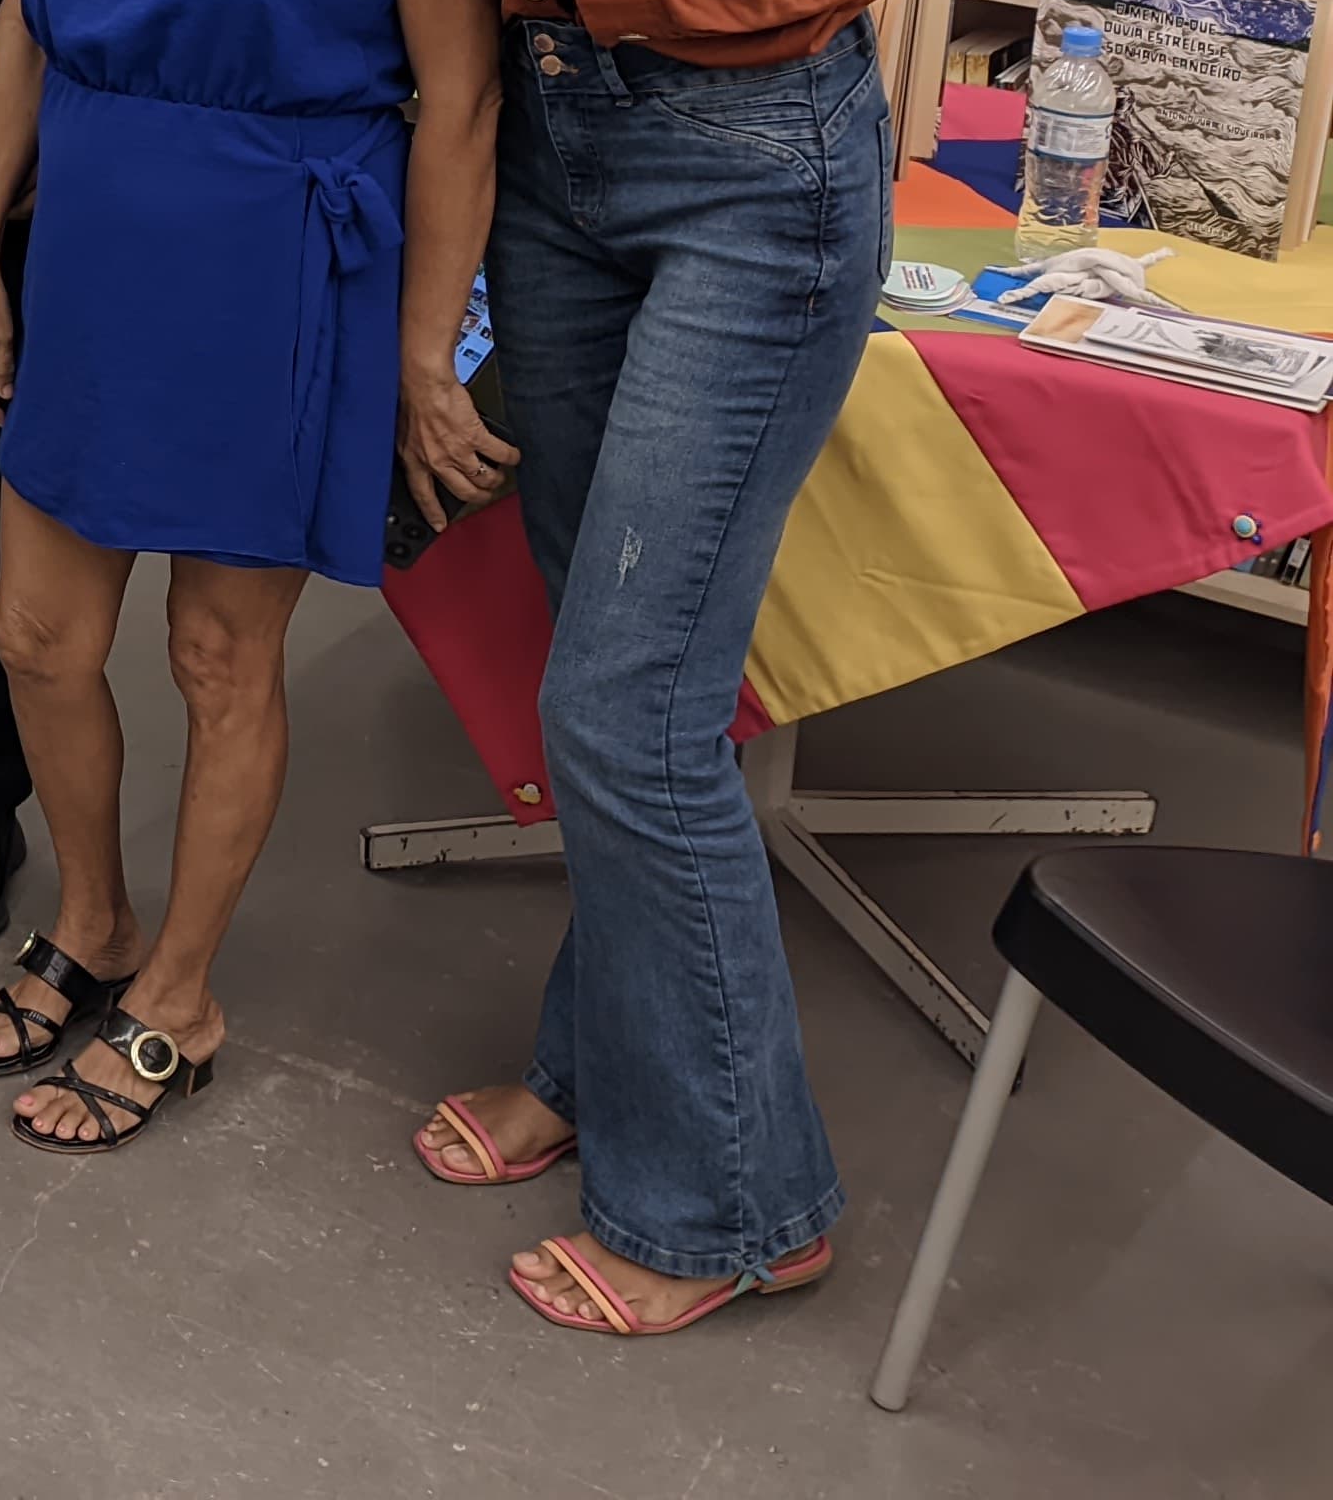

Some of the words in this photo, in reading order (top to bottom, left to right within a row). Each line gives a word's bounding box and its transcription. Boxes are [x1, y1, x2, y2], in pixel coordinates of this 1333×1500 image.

[1128, 4, 1185, 29] MENINO
[1189, 19, 1216, 35] QUE
[1104, 20, 1143, 39] OUVIA
[1147, 32, 1215, 57] ESTRELAS
[1220, 45, 1229, 58] E
[1104, 41, 1167, 65] SONHAVA
[1172, 56, 1242, 83] CANOEIRO
